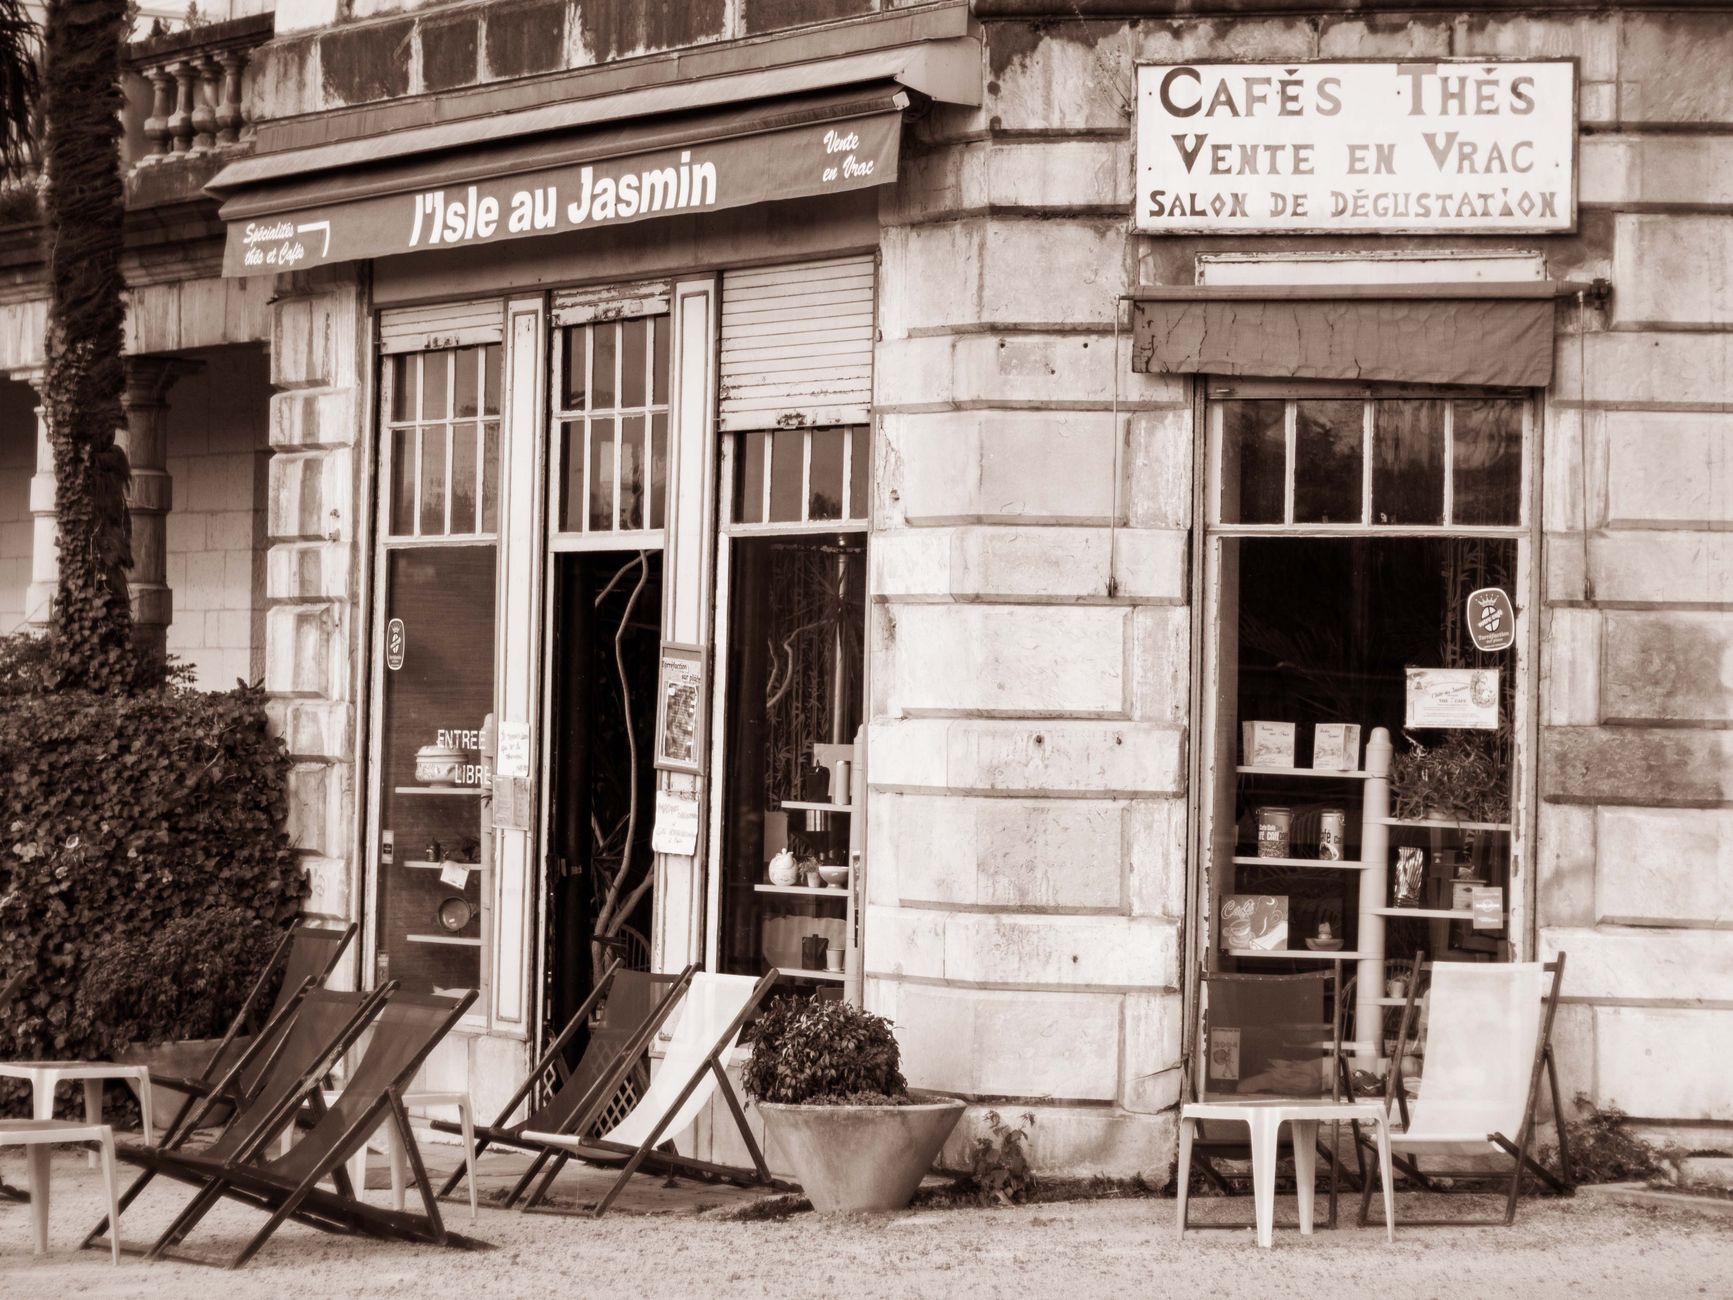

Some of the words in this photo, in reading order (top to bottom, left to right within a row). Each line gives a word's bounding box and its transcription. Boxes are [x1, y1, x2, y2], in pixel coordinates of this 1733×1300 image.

[1159, 66, 1343, 118] CAFÉS
[1396, 63, 1536, 117] THÉS
[823, 129, 860, 155] Vente
[1170, 132, 1316, 176] VENTE
[1346, 143, 1398, 176] EN
[1421, 130, 1535, 175] VRAC
[822, 166, 838, 183] en
[842, 154, 875, 179] Vrac
[508, 186, 557, 233] au
[567, 150, 718, 225] Jasmin
[1148, 189, 1250, 218] SALON
[1269, 190, 1308, 218] DE
[1330, 187, 1558, 219] DÉGUSTATION
[436, 729, 487, 750] ENTREE
[454, 764, 492, 785] LIBRE
